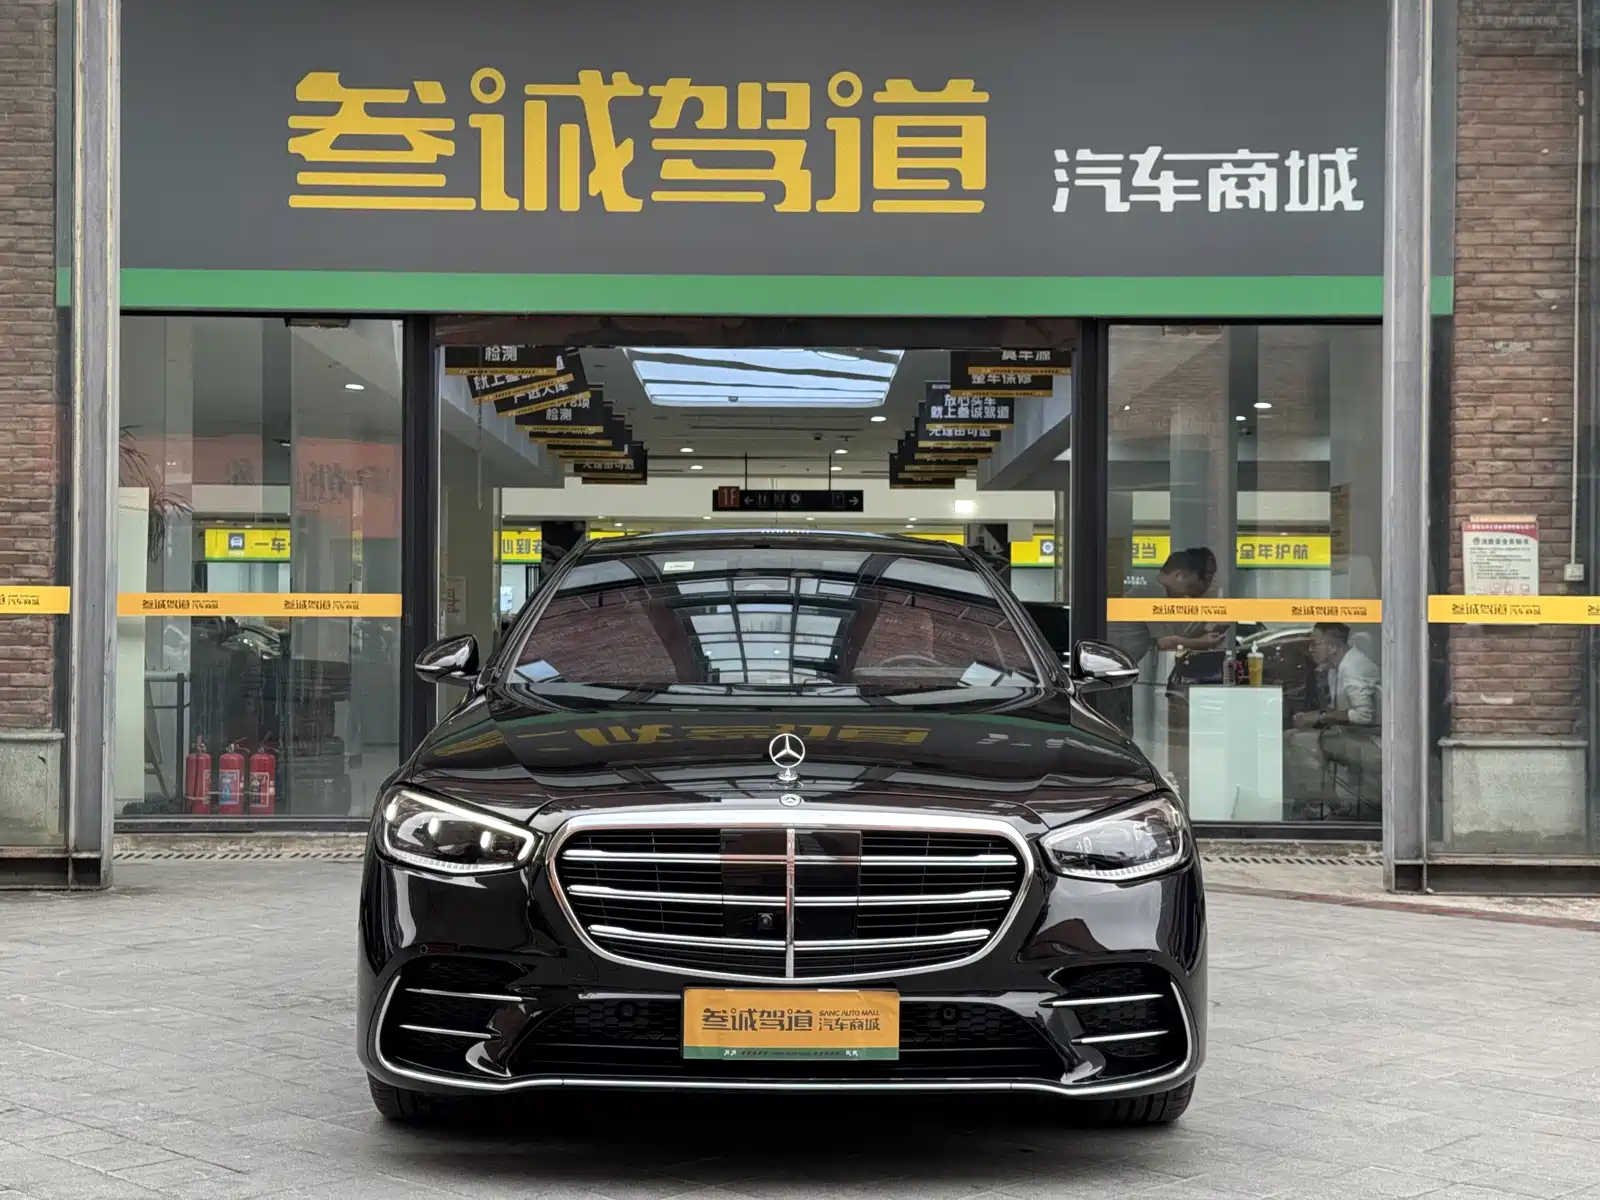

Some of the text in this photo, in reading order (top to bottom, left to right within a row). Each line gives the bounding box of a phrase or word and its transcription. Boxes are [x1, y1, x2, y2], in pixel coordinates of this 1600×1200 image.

[288, 67, 1365, 214] 叁诚驾道 汽车商城
[702, 1008, 812, 1031] 叁诚驾道
[818, 1018, 881, 1031] 汽车商城
